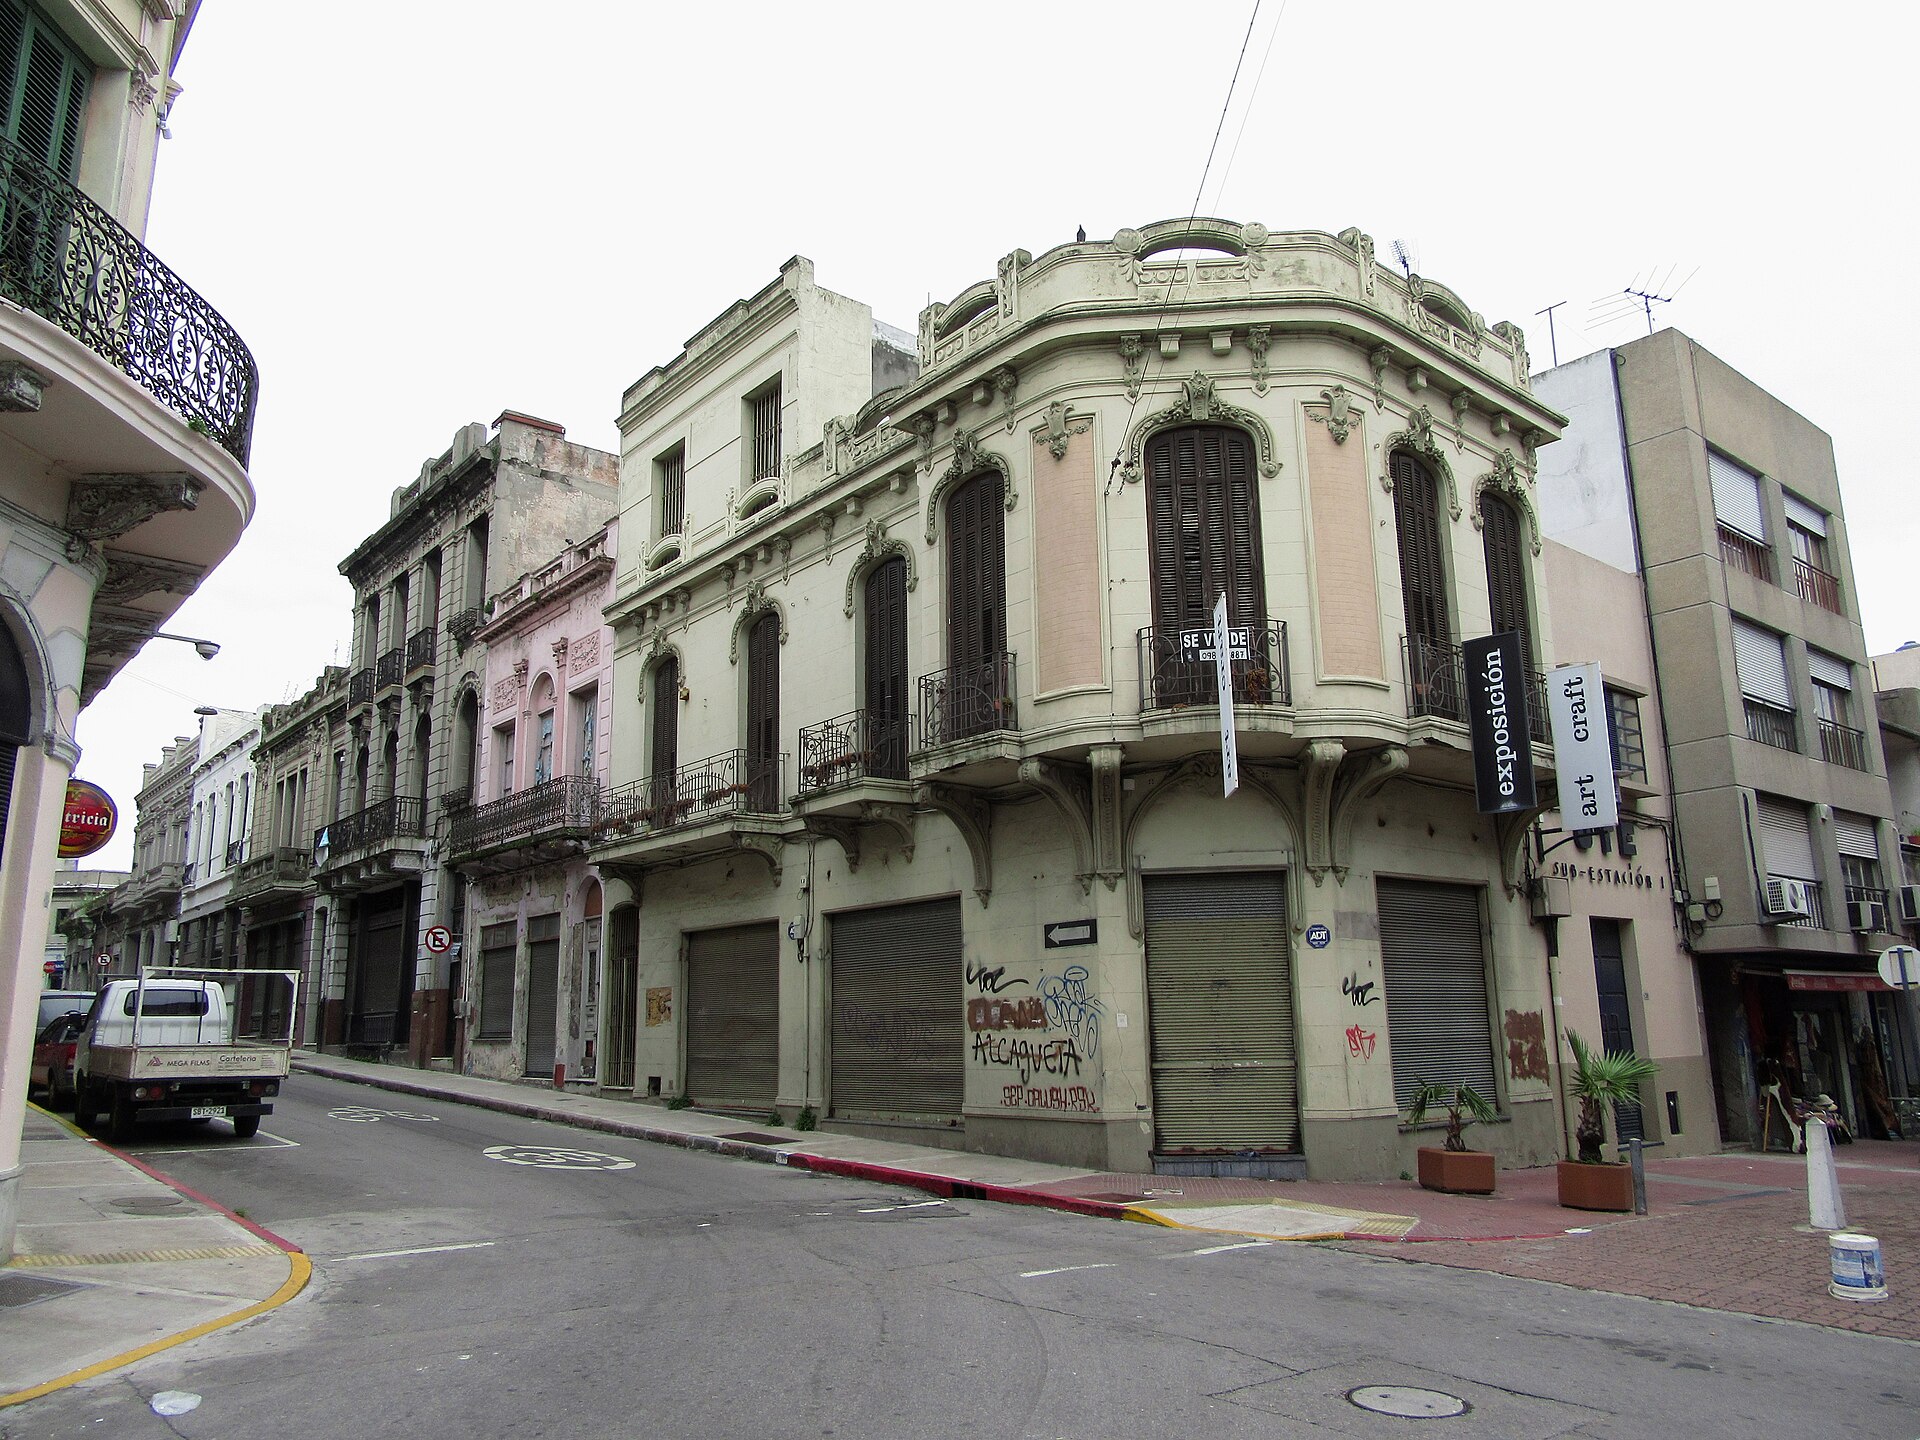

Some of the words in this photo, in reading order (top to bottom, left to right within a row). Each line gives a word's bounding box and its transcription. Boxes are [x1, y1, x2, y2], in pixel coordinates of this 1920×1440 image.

[1183, 634, 1199, 648] SE
[1203, 632, 1246, 647] VDE
[1482, 649, 1516, 796] exposición
[1564, 676, 1589, 742] craft
[1574, 774, 1597, 816] art
[1310, 931, 1327, 940] ADT
